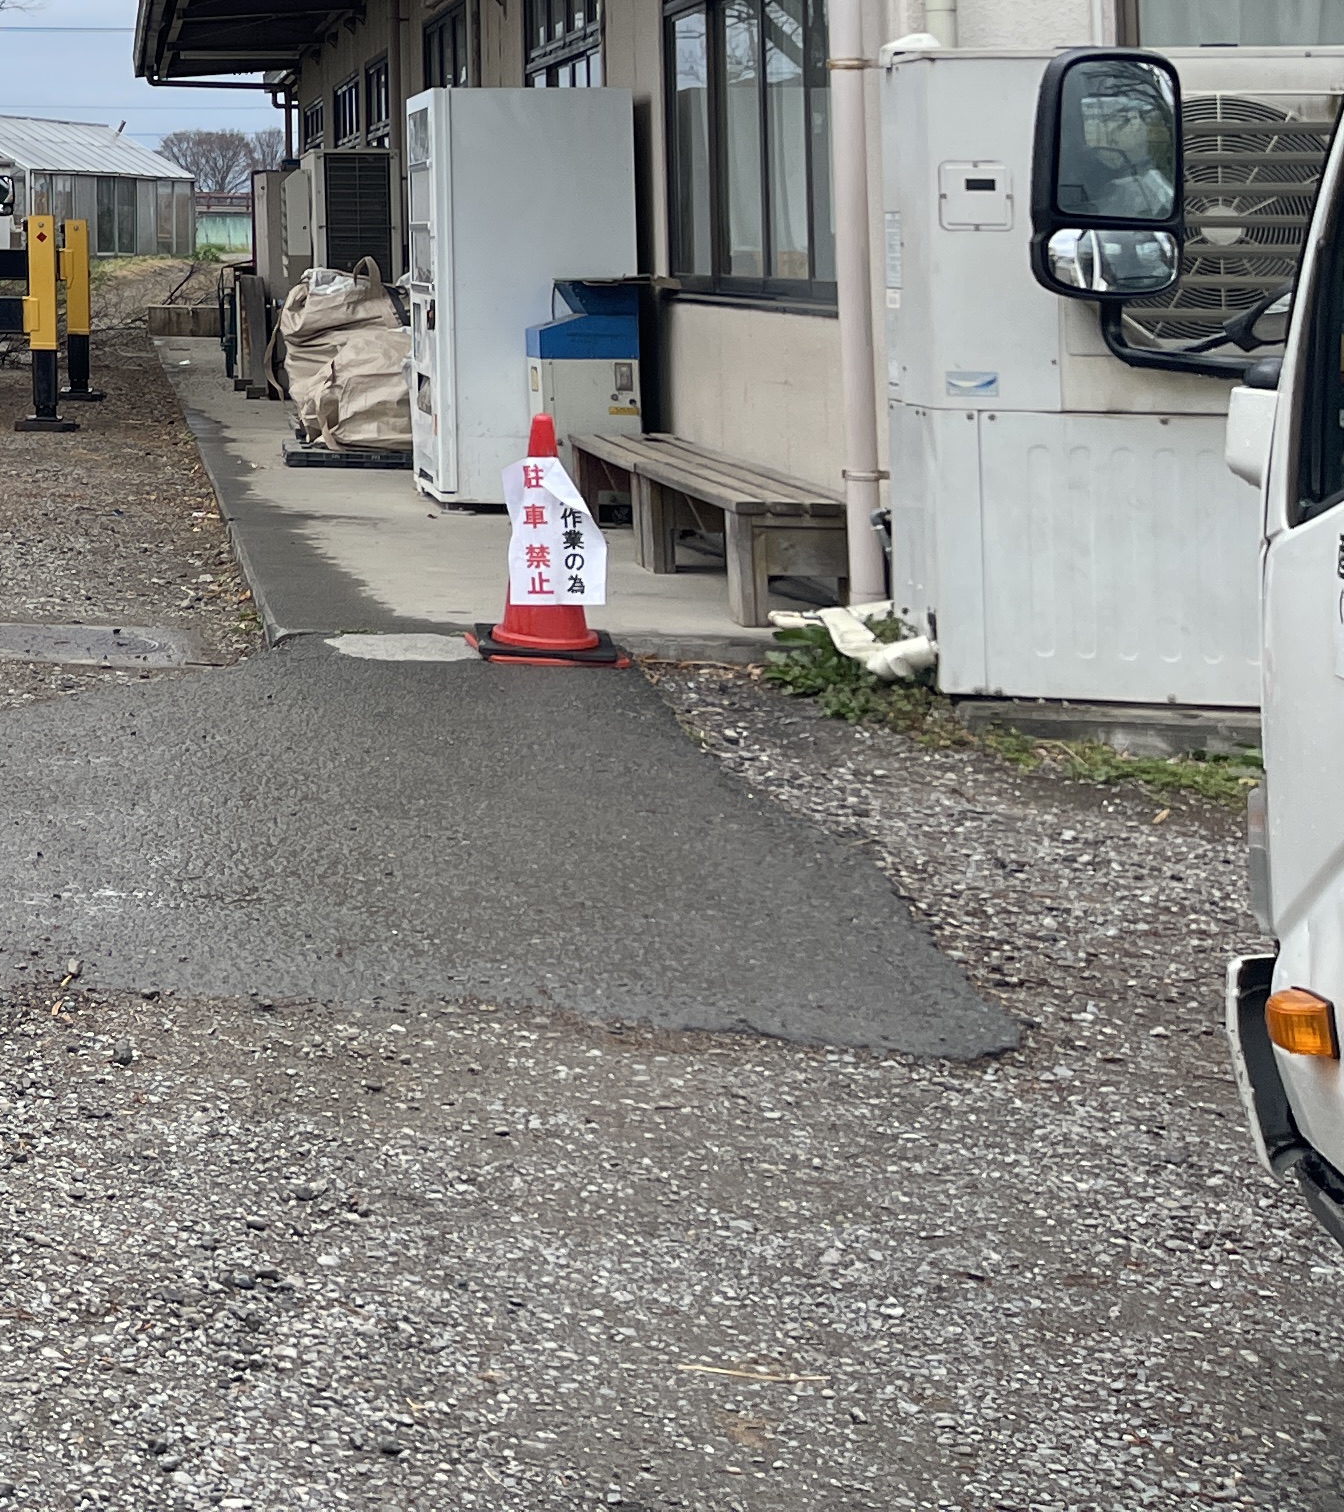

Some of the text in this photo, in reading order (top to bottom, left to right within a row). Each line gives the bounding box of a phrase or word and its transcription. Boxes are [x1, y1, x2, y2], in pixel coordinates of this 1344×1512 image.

[522, 464, 555, 595] 駐車禁止
[560, 501, 586, 595] 作業の為
